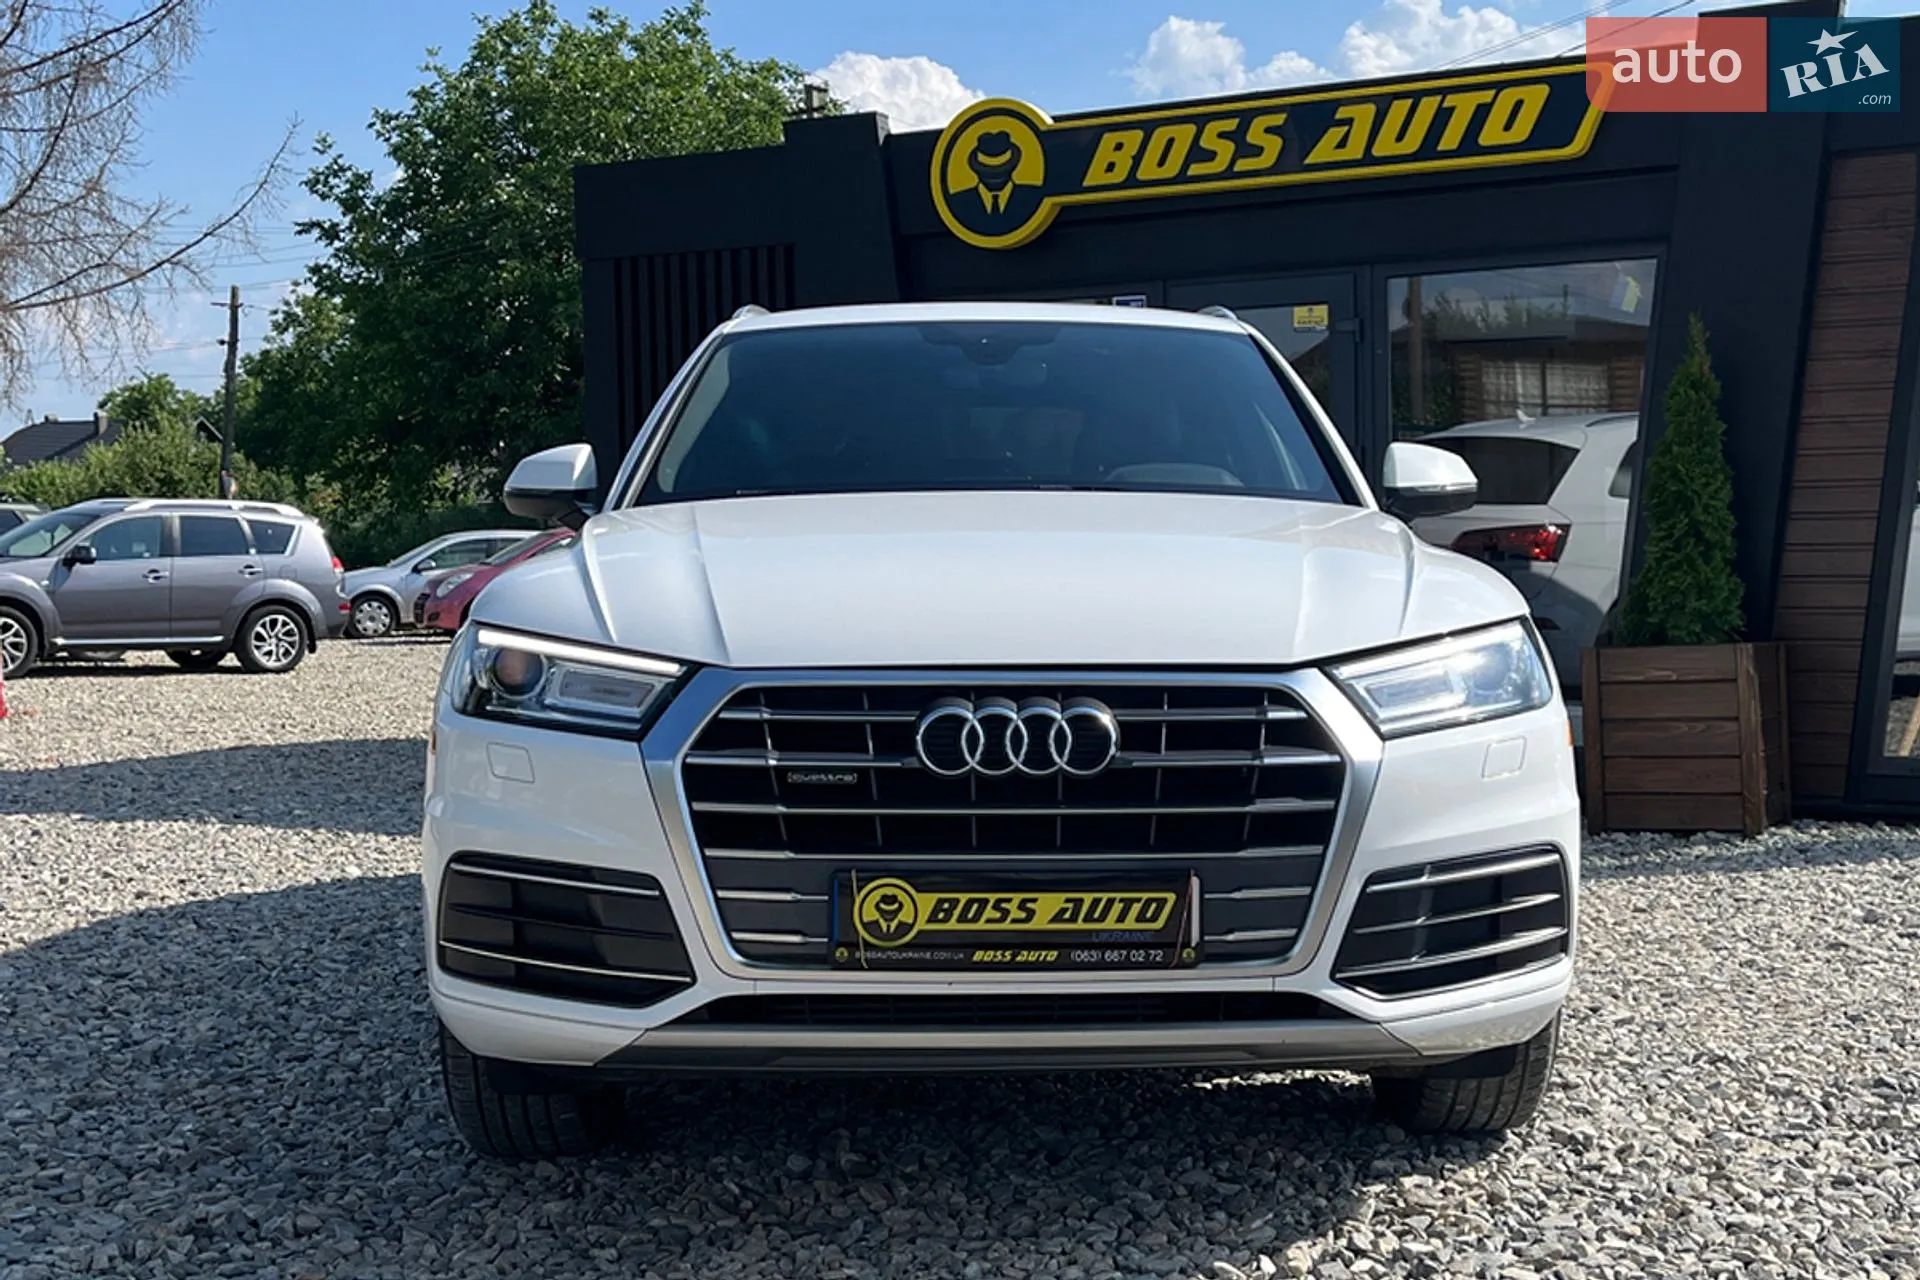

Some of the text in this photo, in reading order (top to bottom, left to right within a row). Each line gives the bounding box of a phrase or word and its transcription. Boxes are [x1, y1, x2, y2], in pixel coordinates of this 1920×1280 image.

[1082, 83, 1551, 187] BOSS AUTO
[925, 897, 1169, 925] BOSS AUTO
[972, 950, 1059, 962] BOSS AUTO
[1070, 949, 1163, 962] (063) 667 02 72
